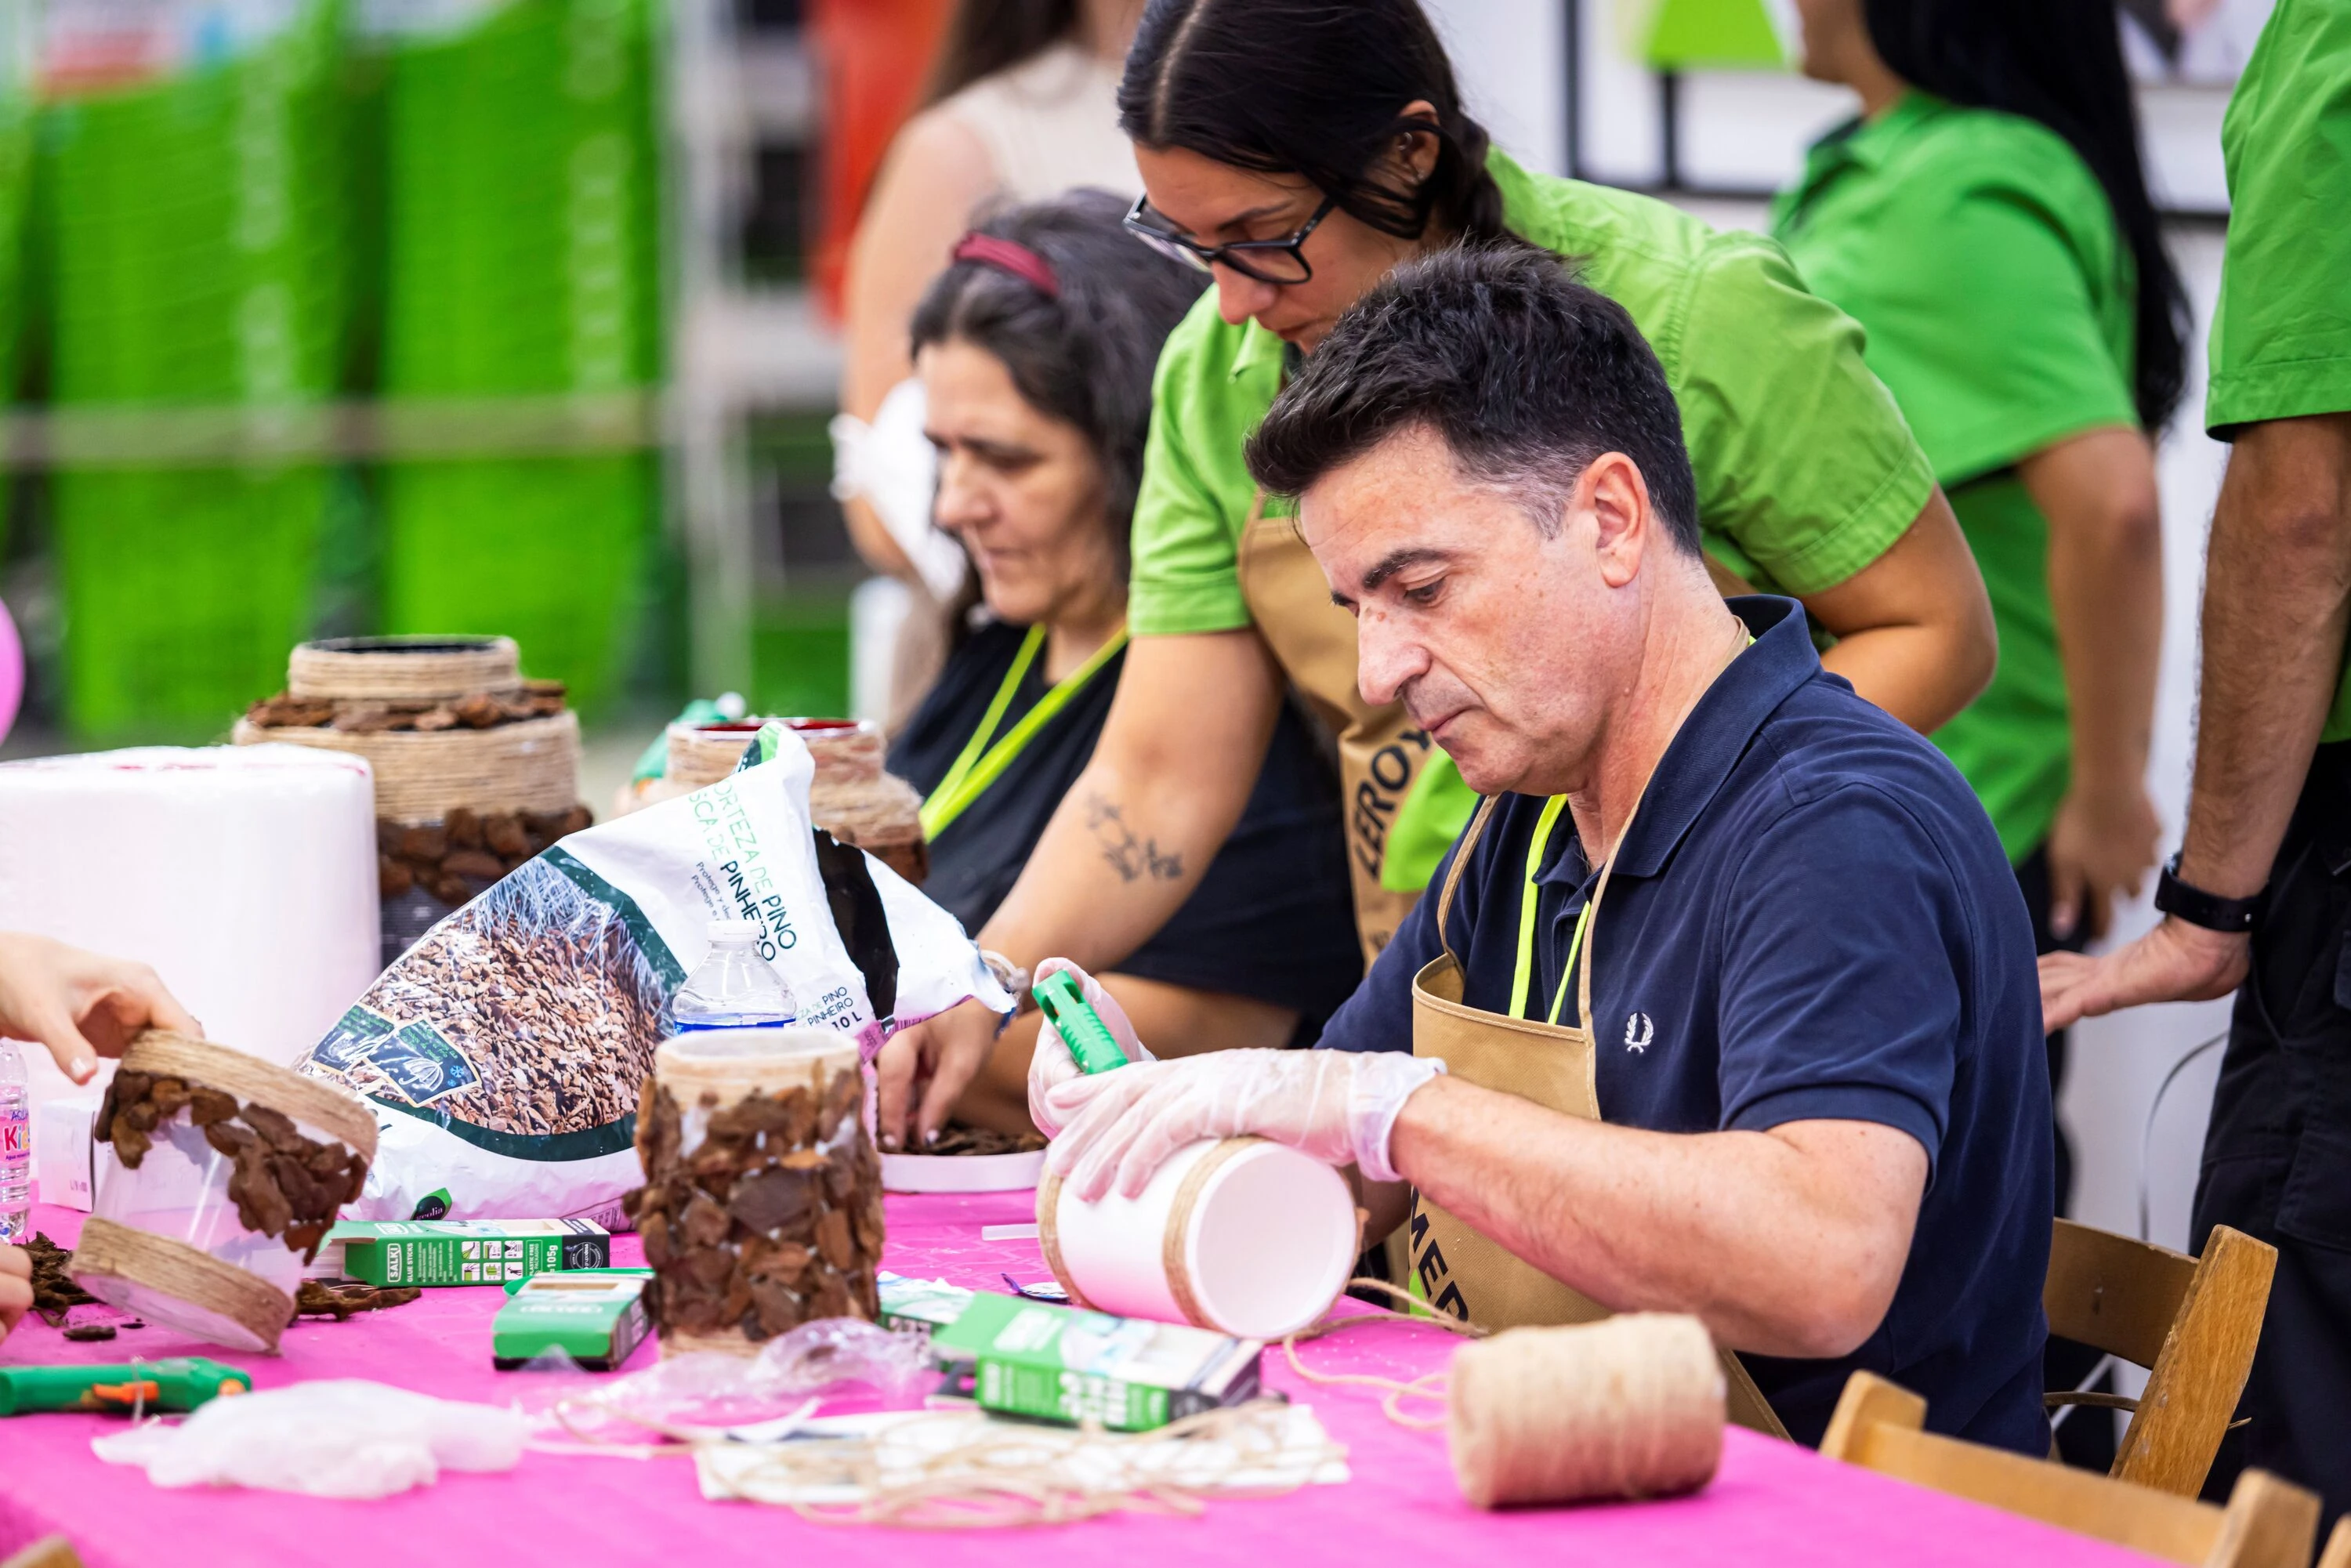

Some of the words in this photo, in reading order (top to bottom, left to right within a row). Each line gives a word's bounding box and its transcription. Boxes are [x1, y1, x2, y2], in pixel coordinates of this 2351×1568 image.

[1355, 730, 1431, 882] LEROY
[689, 792, 719, 833] SCA
[720, 860, 776, 961] PINHERO
[696, 861, 720, 896] Protege
[714, 780, 760, 864] ORTEZA
[750, 867, 773, 893] DE
[762, 894, 797, 950] PINO
[691, 875, 714, 908] Protege
[822, 987, 847, 1005] PINO
[807, 998, 853, 1027] PINHEIRO
[831, 1016, 850, 1031] 10
[852, 1012, 862, 1022] L
[5, 1124, 30, 1151] Kid
[389, 1248, 398, 1278] SALKI
[546, 1244, 558, 1267] 105g
[1411, 1186, 1469, 1322] MER
